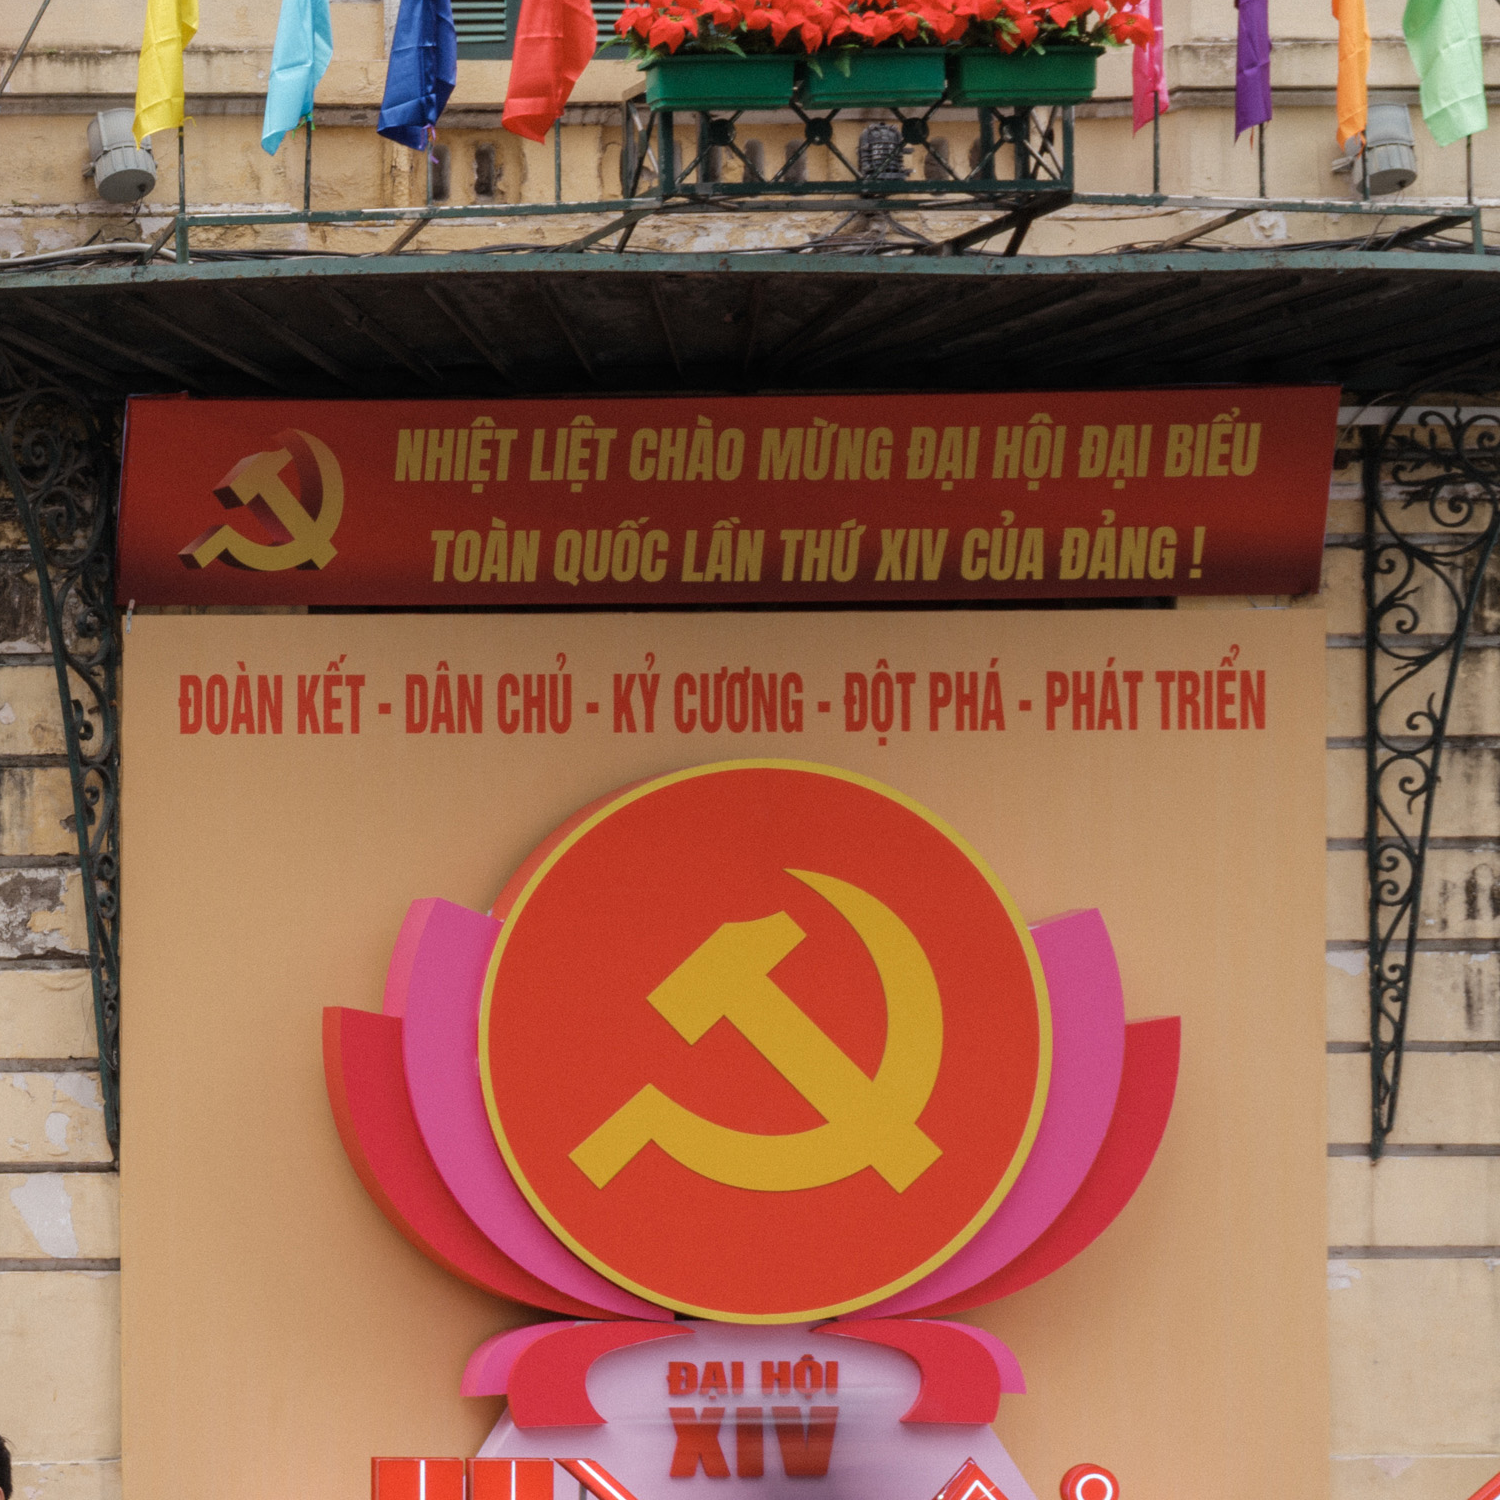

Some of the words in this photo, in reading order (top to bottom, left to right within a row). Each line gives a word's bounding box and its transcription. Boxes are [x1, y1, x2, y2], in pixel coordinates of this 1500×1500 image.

[394, 416, 518, 493] NHIỆT
[529, 415, 617, 492] LIỆT
[629, 414, 745, 481] CHÀO
[757, 415, 894, 481] MỪNG
[906, 424, 981, 491] ĐẠI
[992, 412, 1067, 491] HỘI
[1077, 424, 1153, 490] ĐẠI
[1164, 407, 1262, 478] BIỂU
[430, 516, 541, 582] TOÀN
[553, 516, 670, 587] QUỐC
[681, 516, 765, 583] LẦN
[779, 518, 867, 582] THỨ
[874, 528, 949, 582] XIV
[960, 510, 1045, 581] CỦA
[1059, 509, 1178, 580] ĐẢNG
[1189, 526, 1206, 579] !
[178, 661, 283, 736] ĐOÀN
[297, 653, 366, 735] KẾT
[404, 660, 484, 734] DÂN
[497, 651, 573, 734] CHỦ
[613, 651, 660, 734] KỶ
[673, 666, 804, 734] CƯƠNG
[843, 658, 916, 746] ĐỘT
[929, 657, 1006, 732] PHÁ
[1045, 656, 1144, 731] PHÁT
[1155, 643, 1266, 730] TRIỂN
[666, 1361, 744, 1400] ĐẠI
[761, 1354, 839, 1400] HỘI
[668, 1406, 839, 1478] XIV
